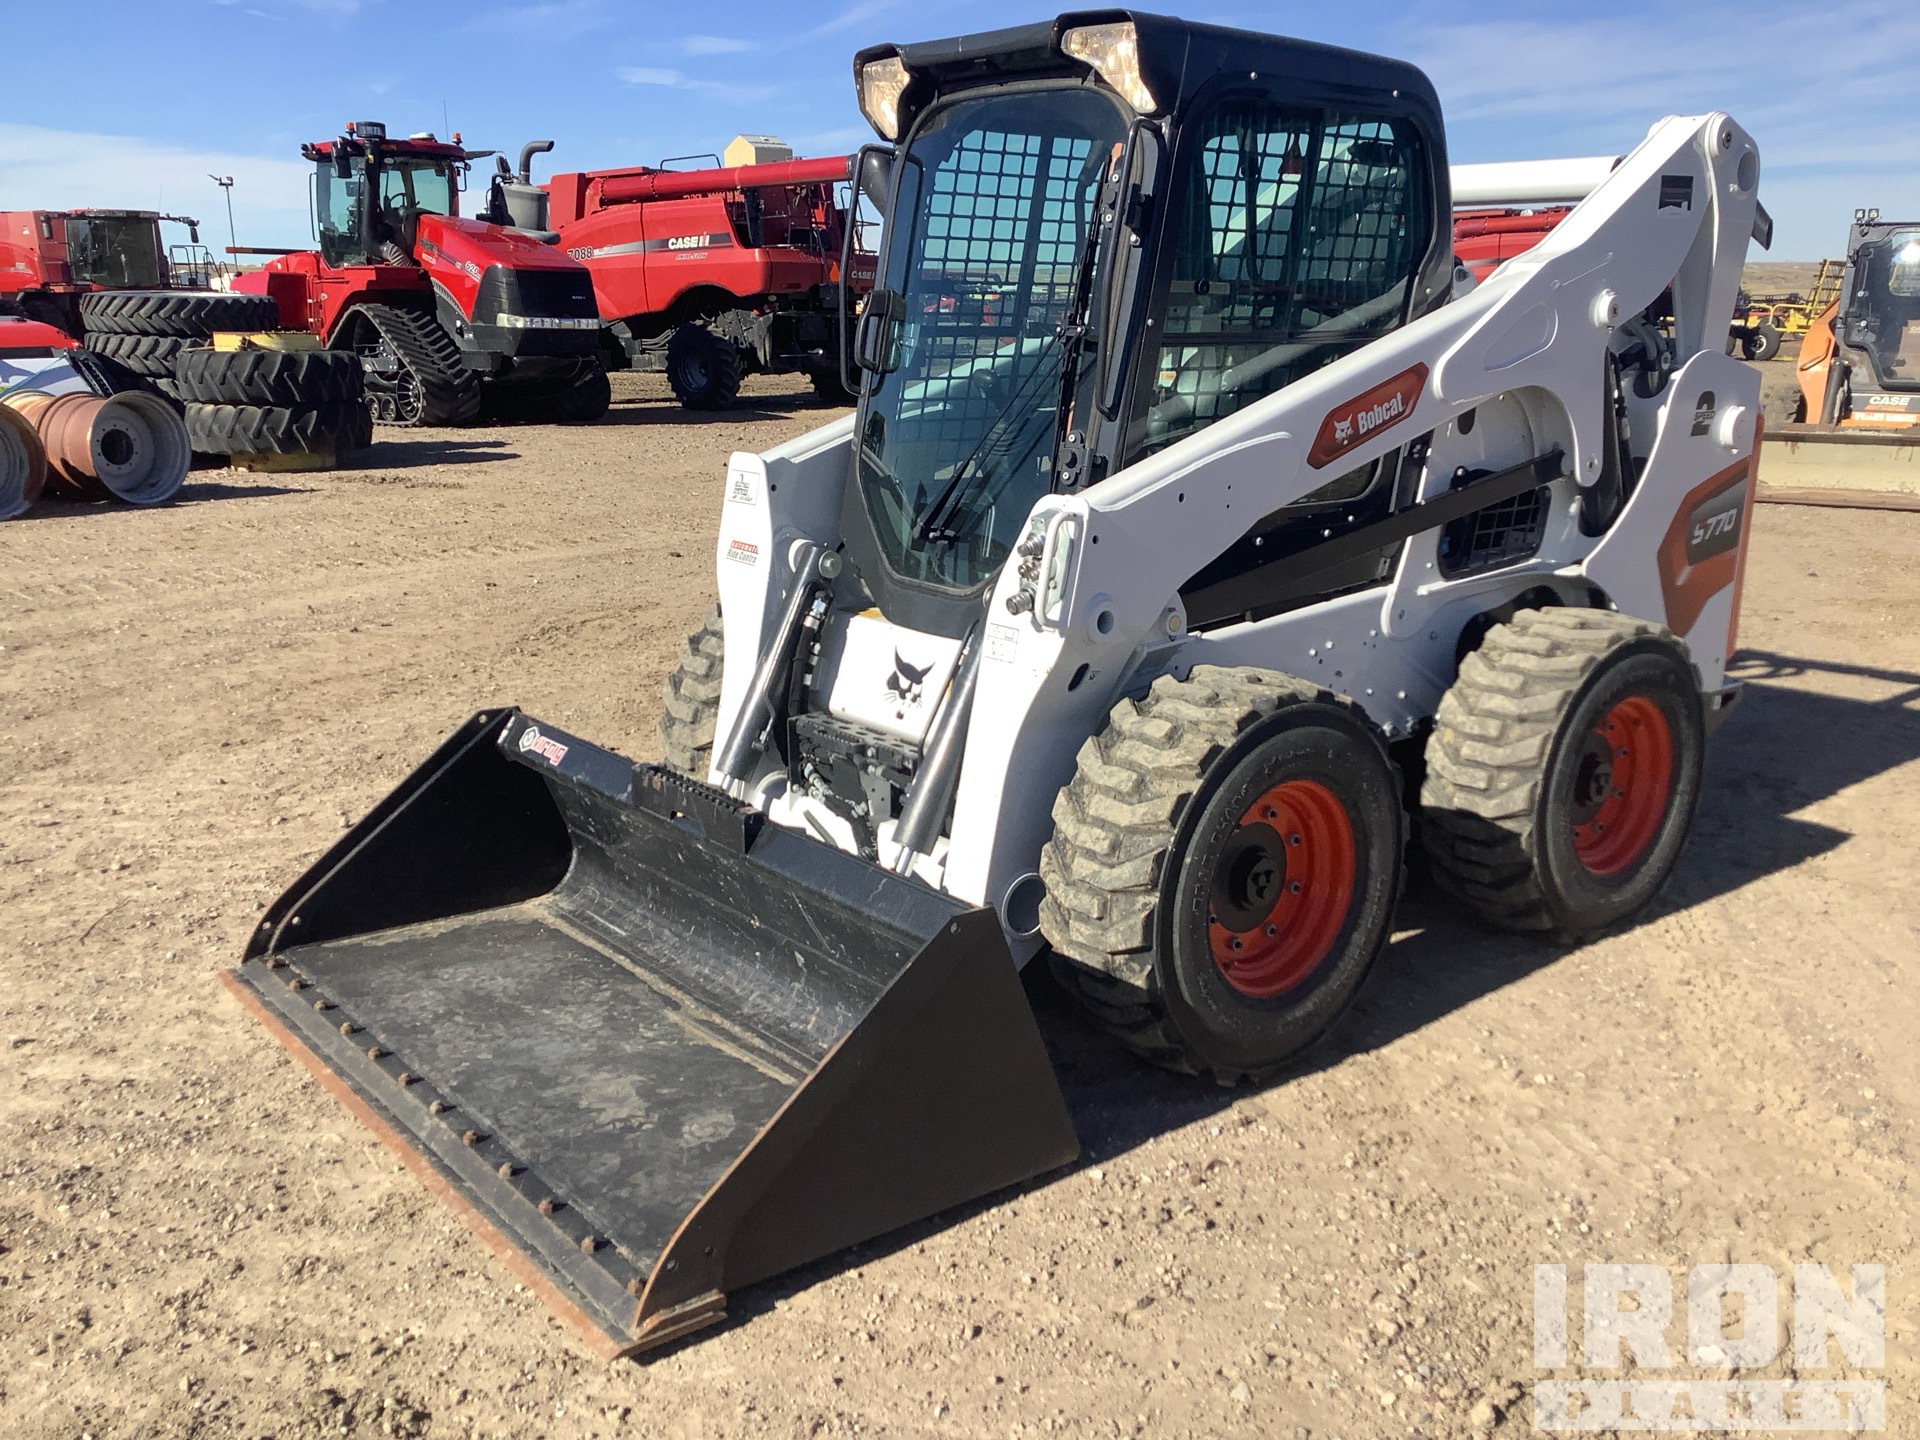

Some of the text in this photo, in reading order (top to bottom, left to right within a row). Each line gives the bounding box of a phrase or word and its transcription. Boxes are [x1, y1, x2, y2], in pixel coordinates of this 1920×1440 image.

[668, 235, 699, 250] CASE
[567, 246, 594, 261] 7088
[1869, 395, 1911, 406] CASE
[1357, 391, 1405, 435] Bobcat
[1692, 508, 1738, 545] S770
[738, 551, 758, 564] Contro
